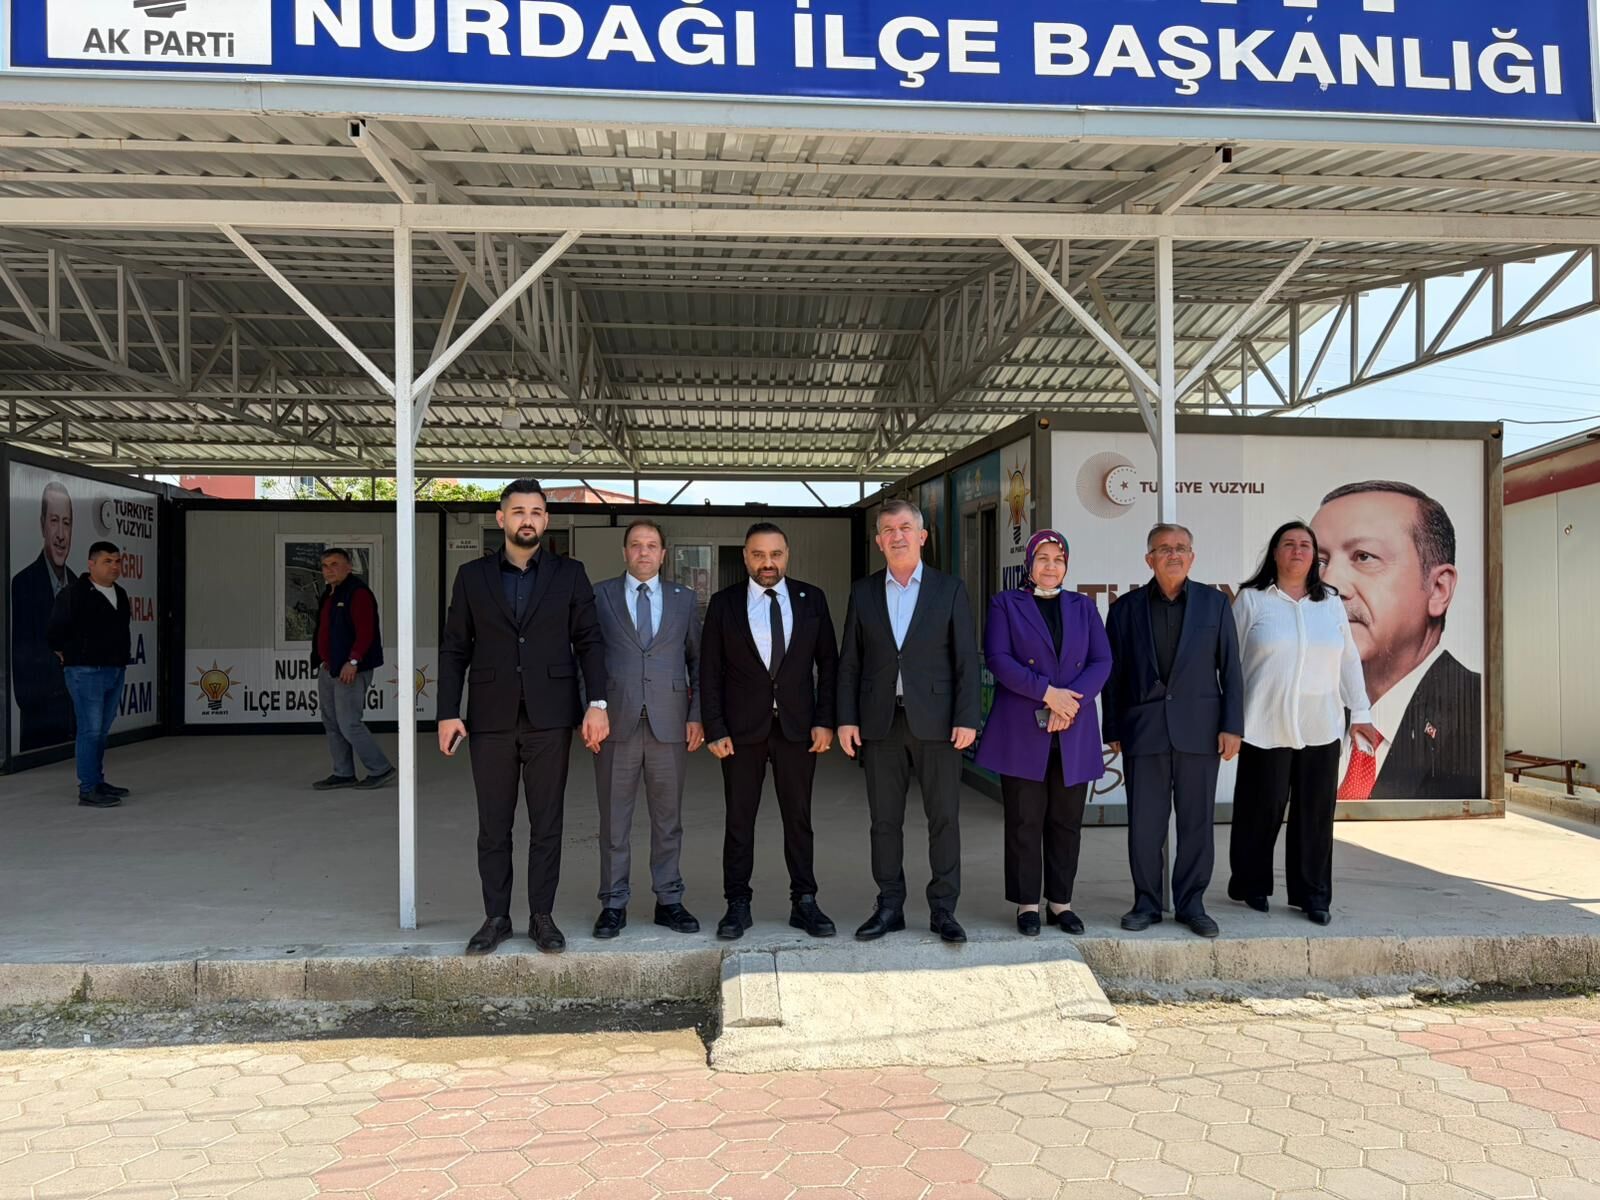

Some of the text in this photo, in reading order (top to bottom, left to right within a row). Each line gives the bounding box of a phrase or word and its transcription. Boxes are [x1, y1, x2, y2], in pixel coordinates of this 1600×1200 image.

[82, 27, 131, 54] AK
[293, 0, 1562, 95] NURDAĞI İLÇE BAŞKANLIĞI
[243, 685, 281, 717] İLÇE
